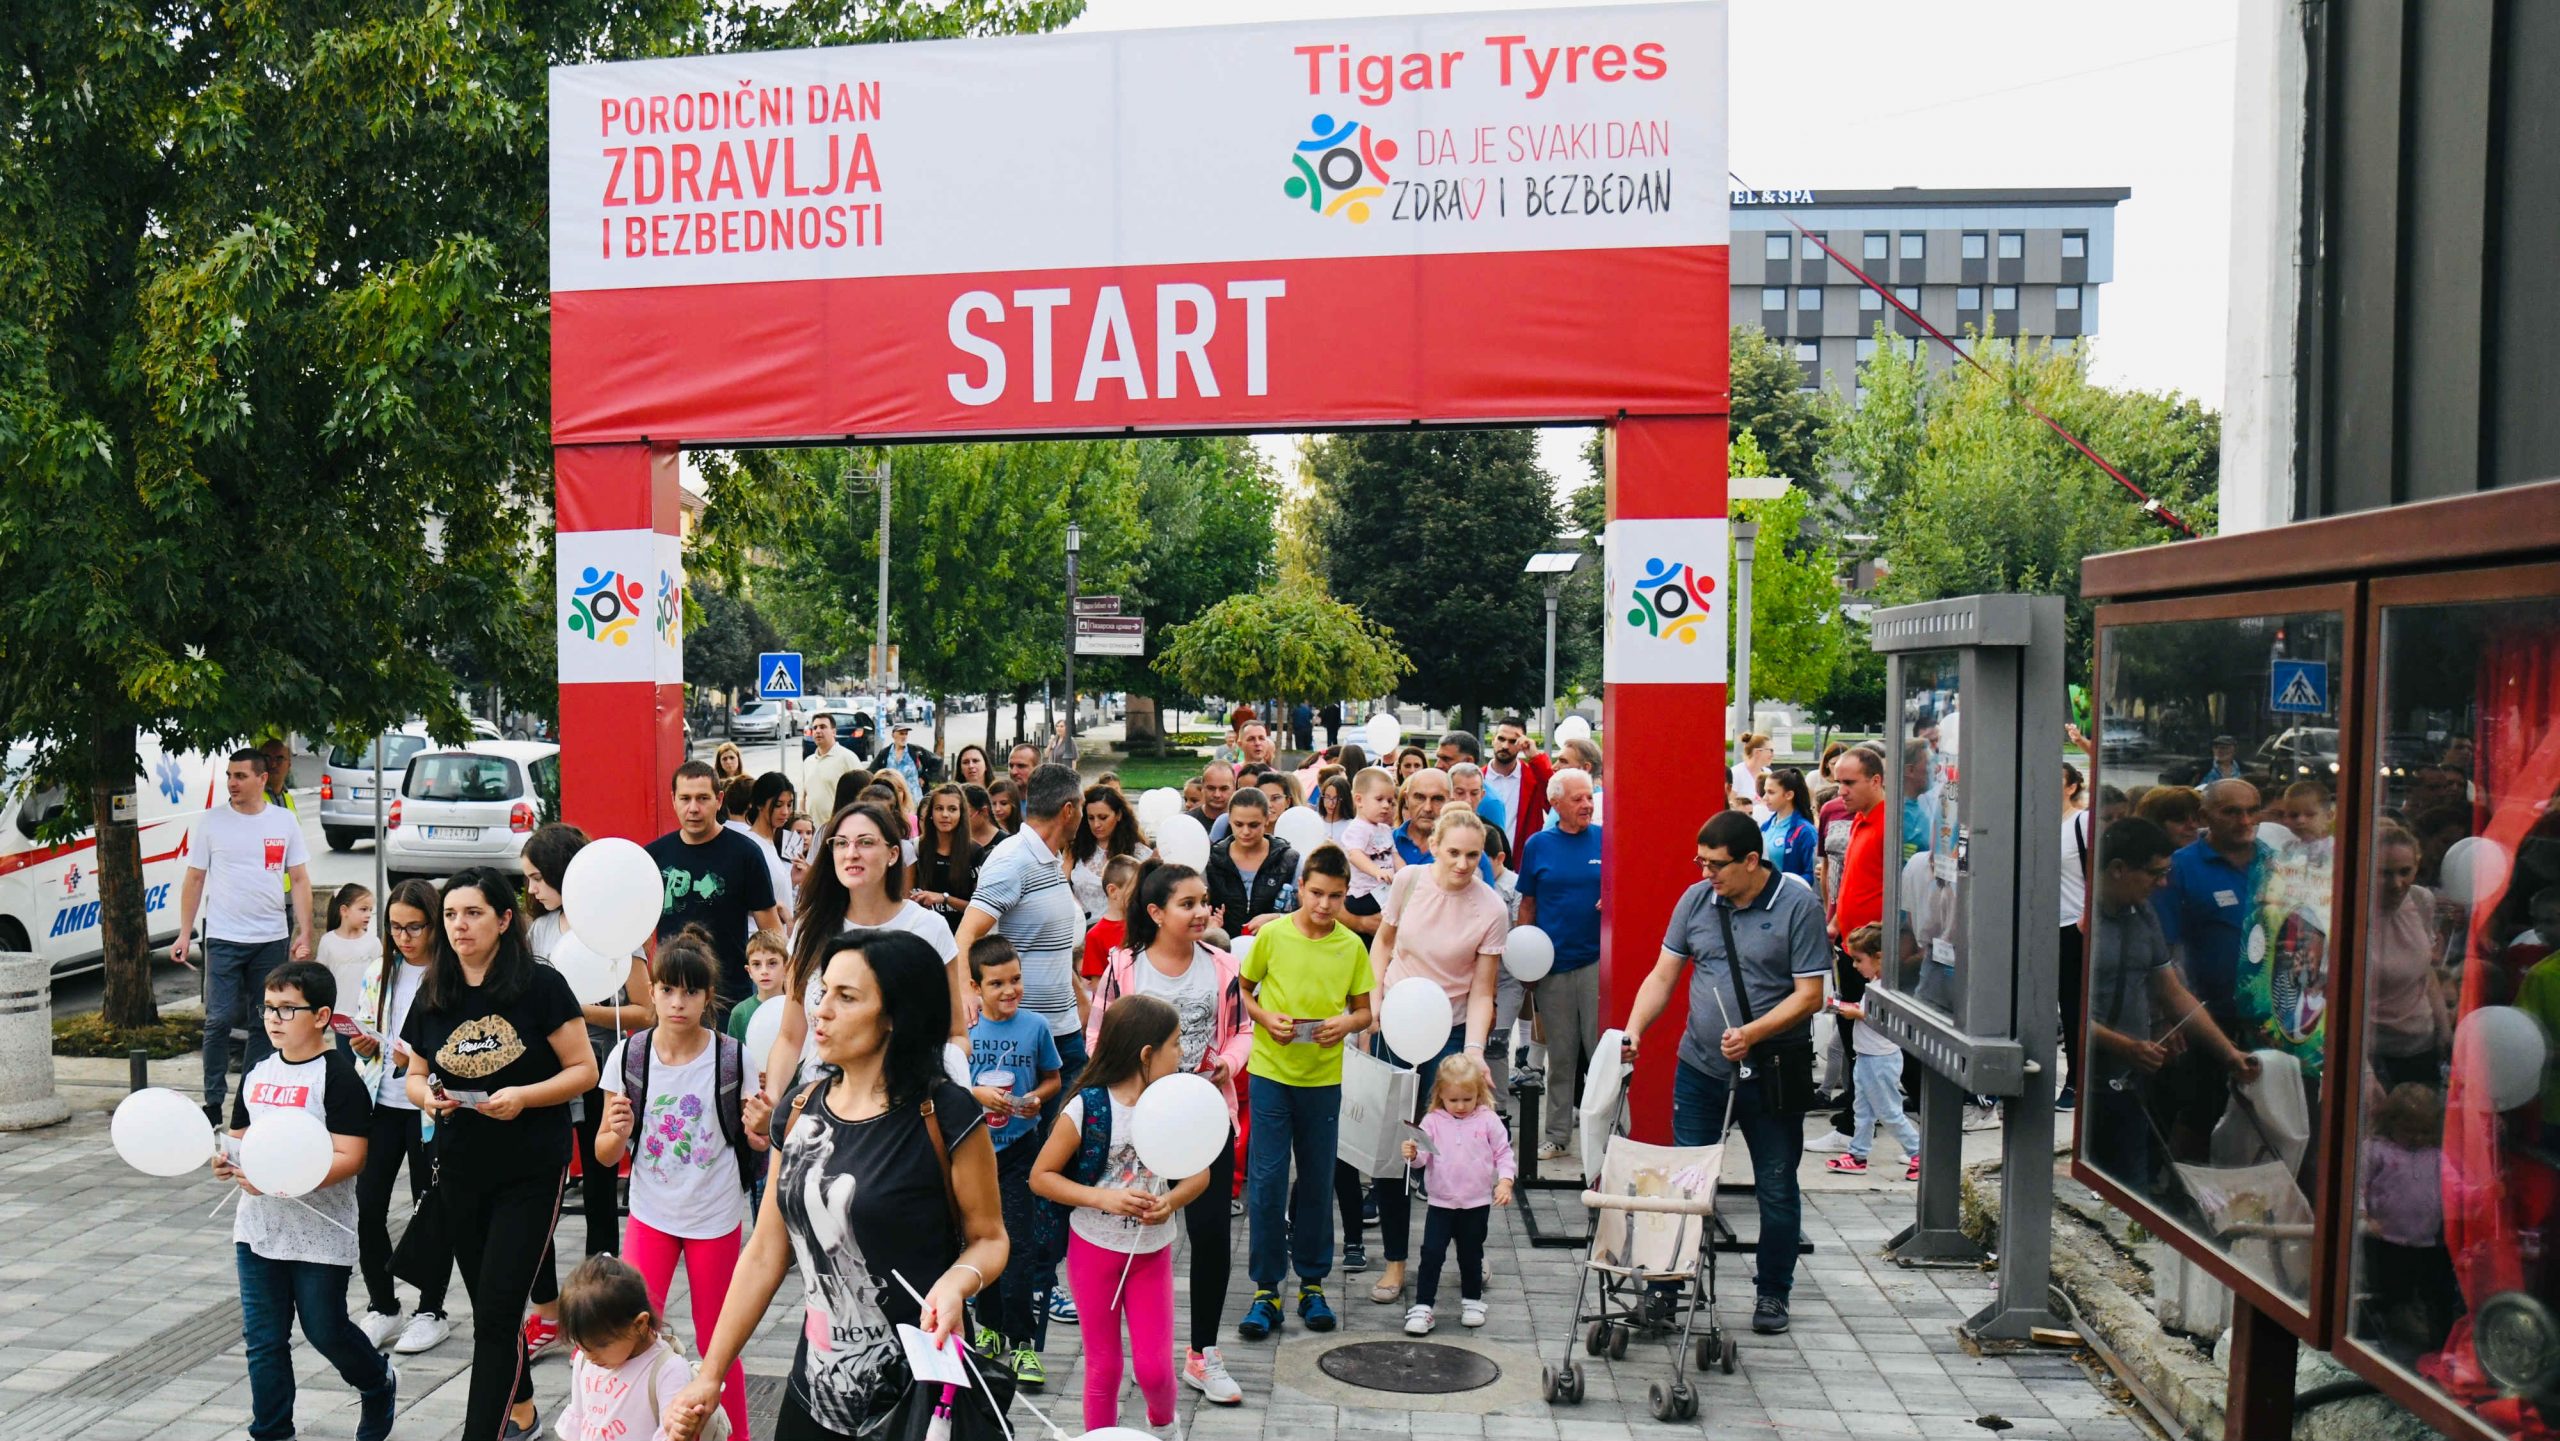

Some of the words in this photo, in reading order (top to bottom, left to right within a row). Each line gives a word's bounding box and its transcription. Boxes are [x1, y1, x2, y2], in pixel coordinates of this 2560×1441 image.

[1294, 43, 1464, 106] Tigar
[1484, 35, 1668, 99] Tyres
[602, 79, 793, 137] PORODIČNI
[808, 81, 881, 124] DAN
[1418, 128, 1458, 166] DA
[1468, 126, 1497, 164] JE
[1508, 121, 1597, 163] SVAKI
[1607, 119, 1669, 160] DAN
[602, 133, 883, 207] ZDRAVLJA
[1499, 177, 1505, 218] I
[1526, 168, 1671, 218] BEZBEDAN
[1730, 190, 1758, 204] EL
[1778, 190, 1814, 204] SPA
[603, 218, 610, 259] I
[625, 203, 883, 258] BEZBEDNOSTI
[947, 279, 1286, 406] START
[968, 1053, 997, 1066] OUR
[1003, 1055, 1032, 1068] LIFE
[973, 1039, 1019, 1052] ENJOY
[257, 1084, 300, 1105] SKATE
[832, 1324, 888, 1343] new
